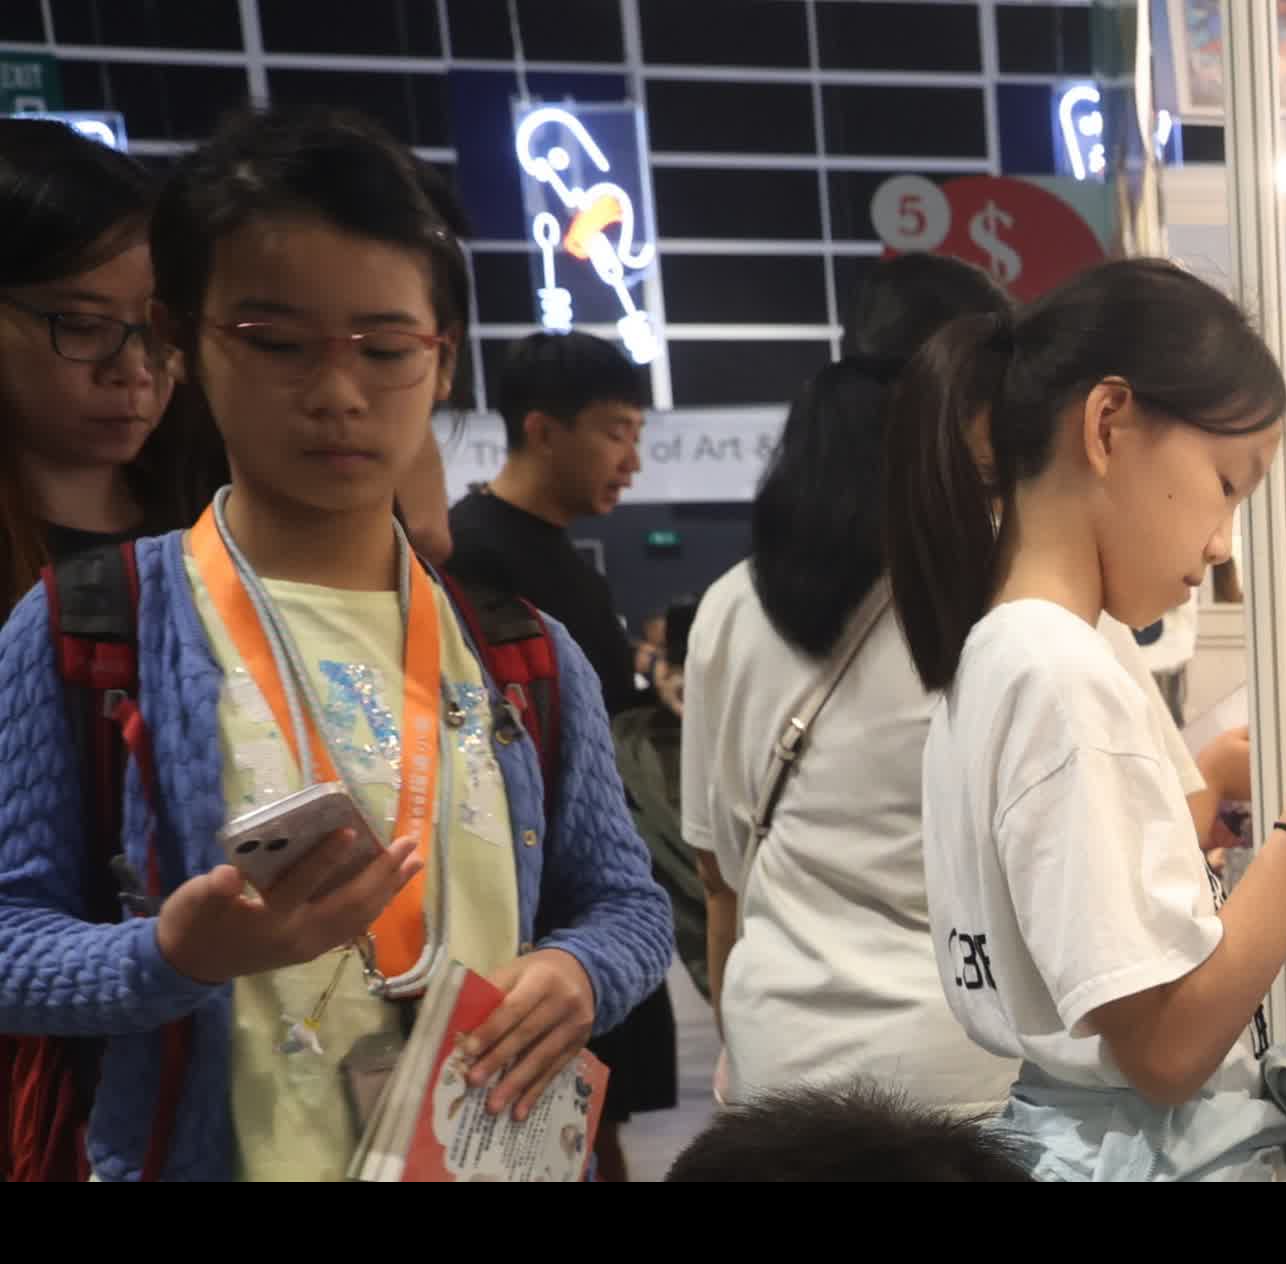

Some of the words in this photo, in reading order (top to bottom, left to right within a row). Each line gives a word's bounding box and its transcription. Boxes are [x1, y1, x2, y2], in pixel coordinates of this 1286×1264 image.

[897, 193, 927, 239] 5
[969, 200, 1023, 285] $
[650, 435, 681, 463] of
[696, 435, 744, 462] Art
